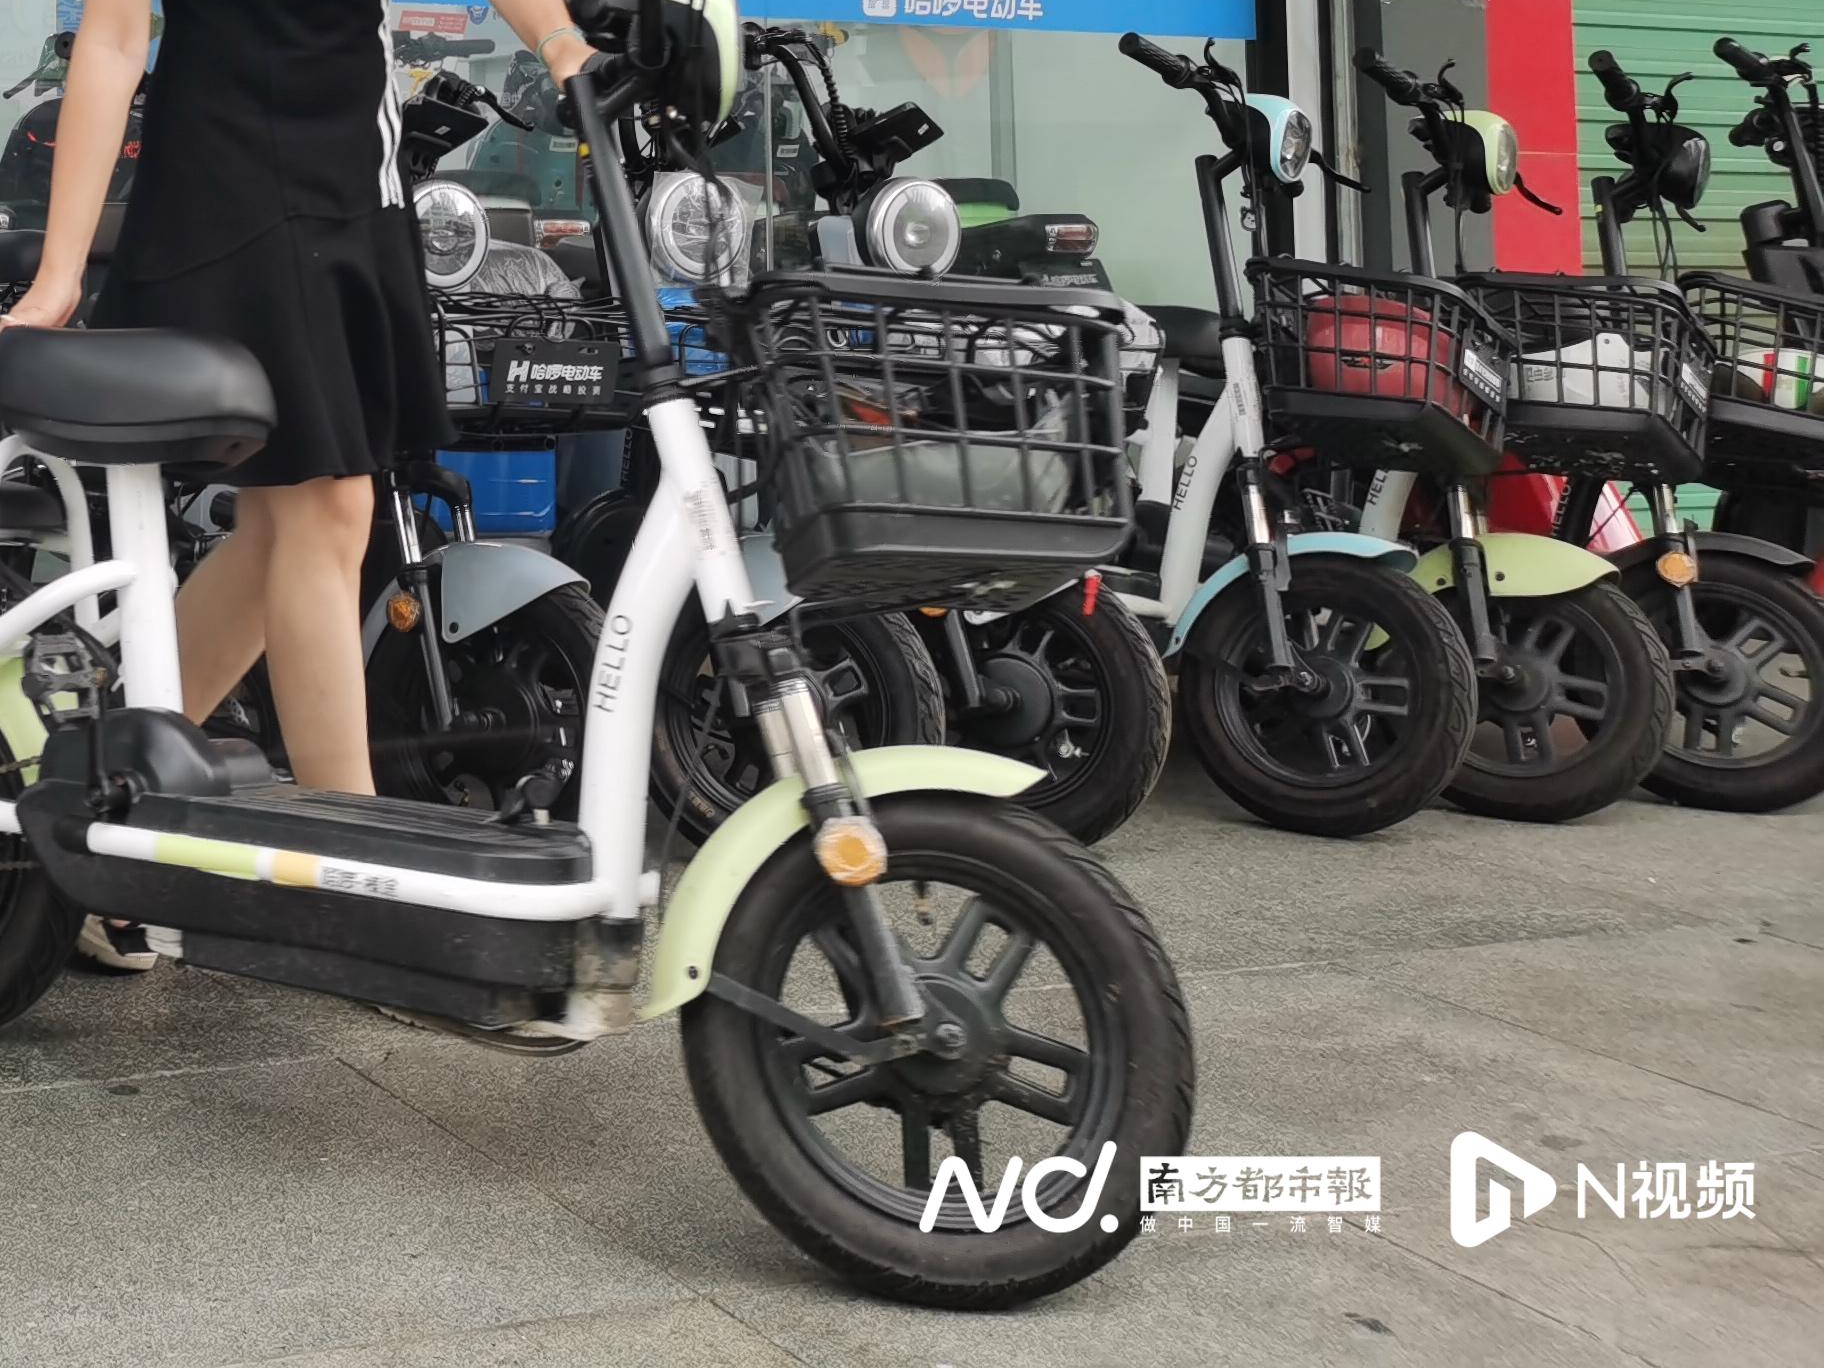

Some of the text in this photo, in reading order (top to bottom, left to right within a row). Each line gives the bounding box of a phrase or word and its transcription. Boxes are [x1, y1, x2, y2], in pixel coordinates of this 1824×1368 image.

[531, 363, 604, 382] 哈啰电动车
[1172, 454, 1198, 512] HELLO
[592, 614, 633, 714] HELLO
